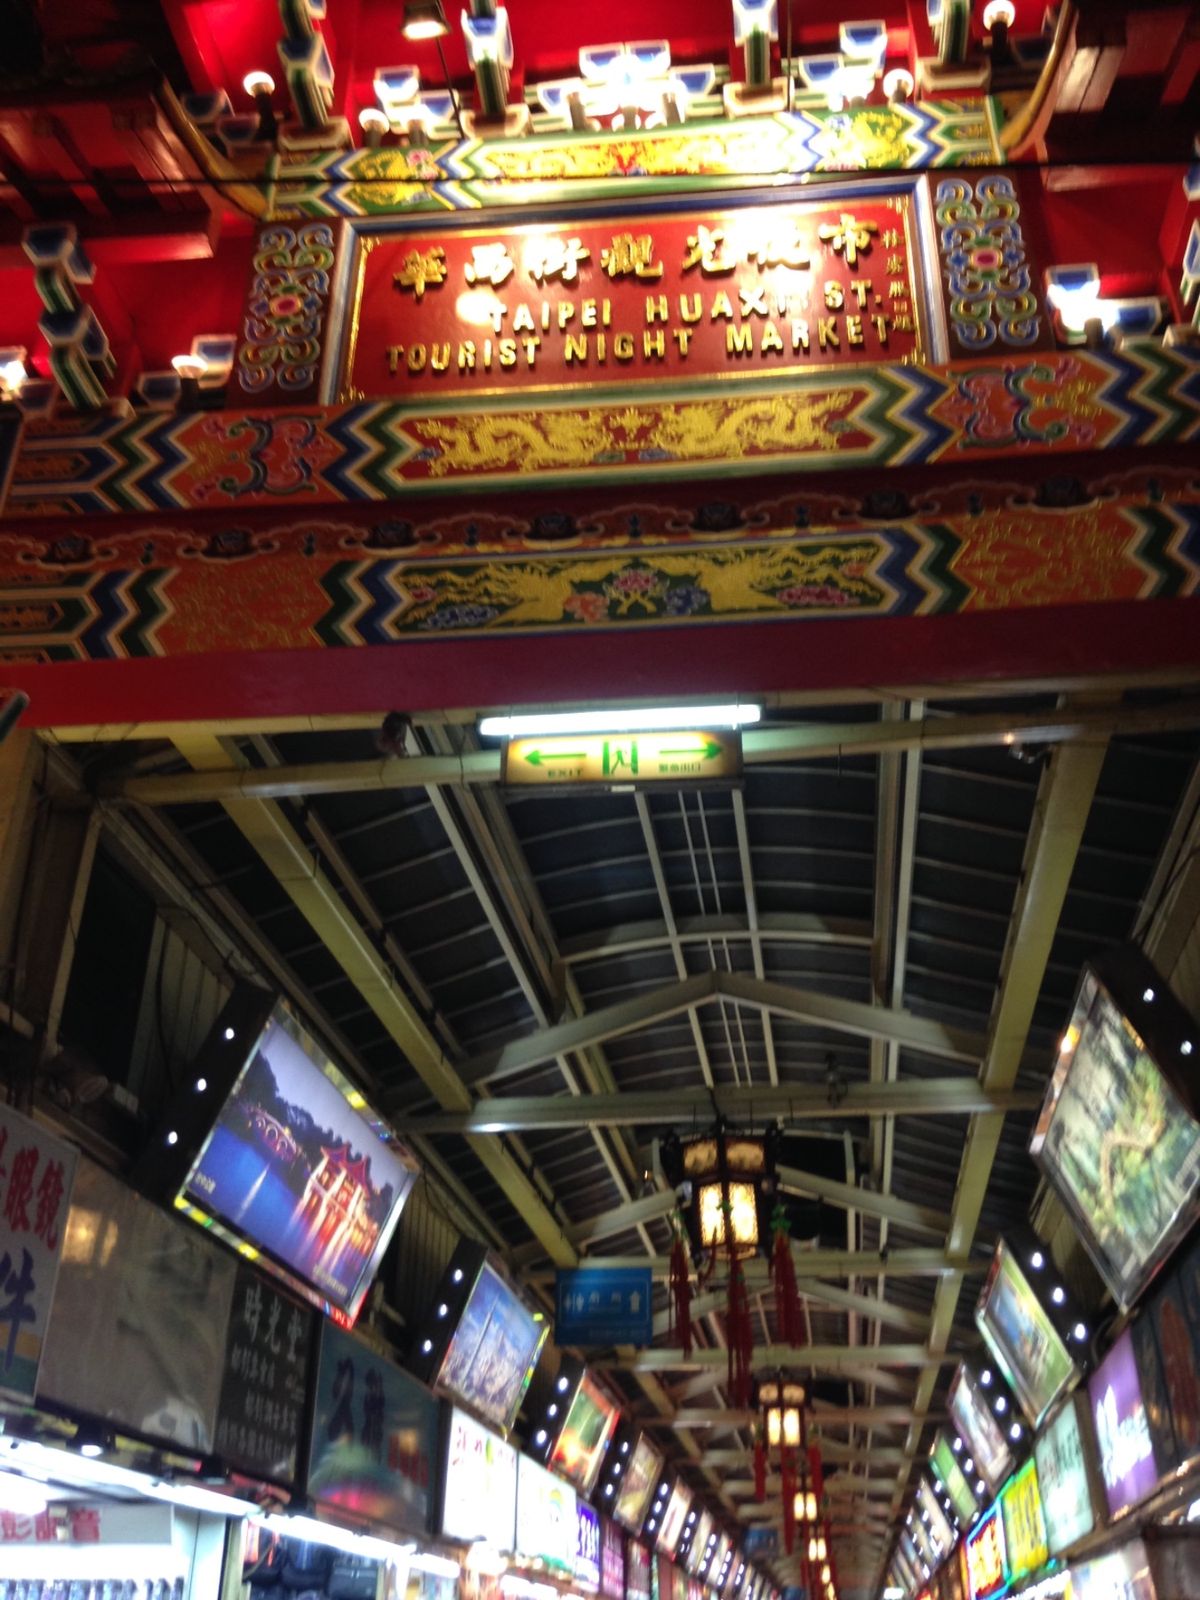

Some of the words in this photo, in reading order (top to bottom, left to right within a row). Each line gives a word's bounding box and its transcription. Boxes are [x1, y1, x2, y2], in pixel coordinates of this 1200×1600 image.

[489, 296, 612, 332] TAIPEI
[385, 335, 541, 372] TOURIST
[564, 327, 693, 362] NIGHT
[725, 313, 890, 353] MARKET
